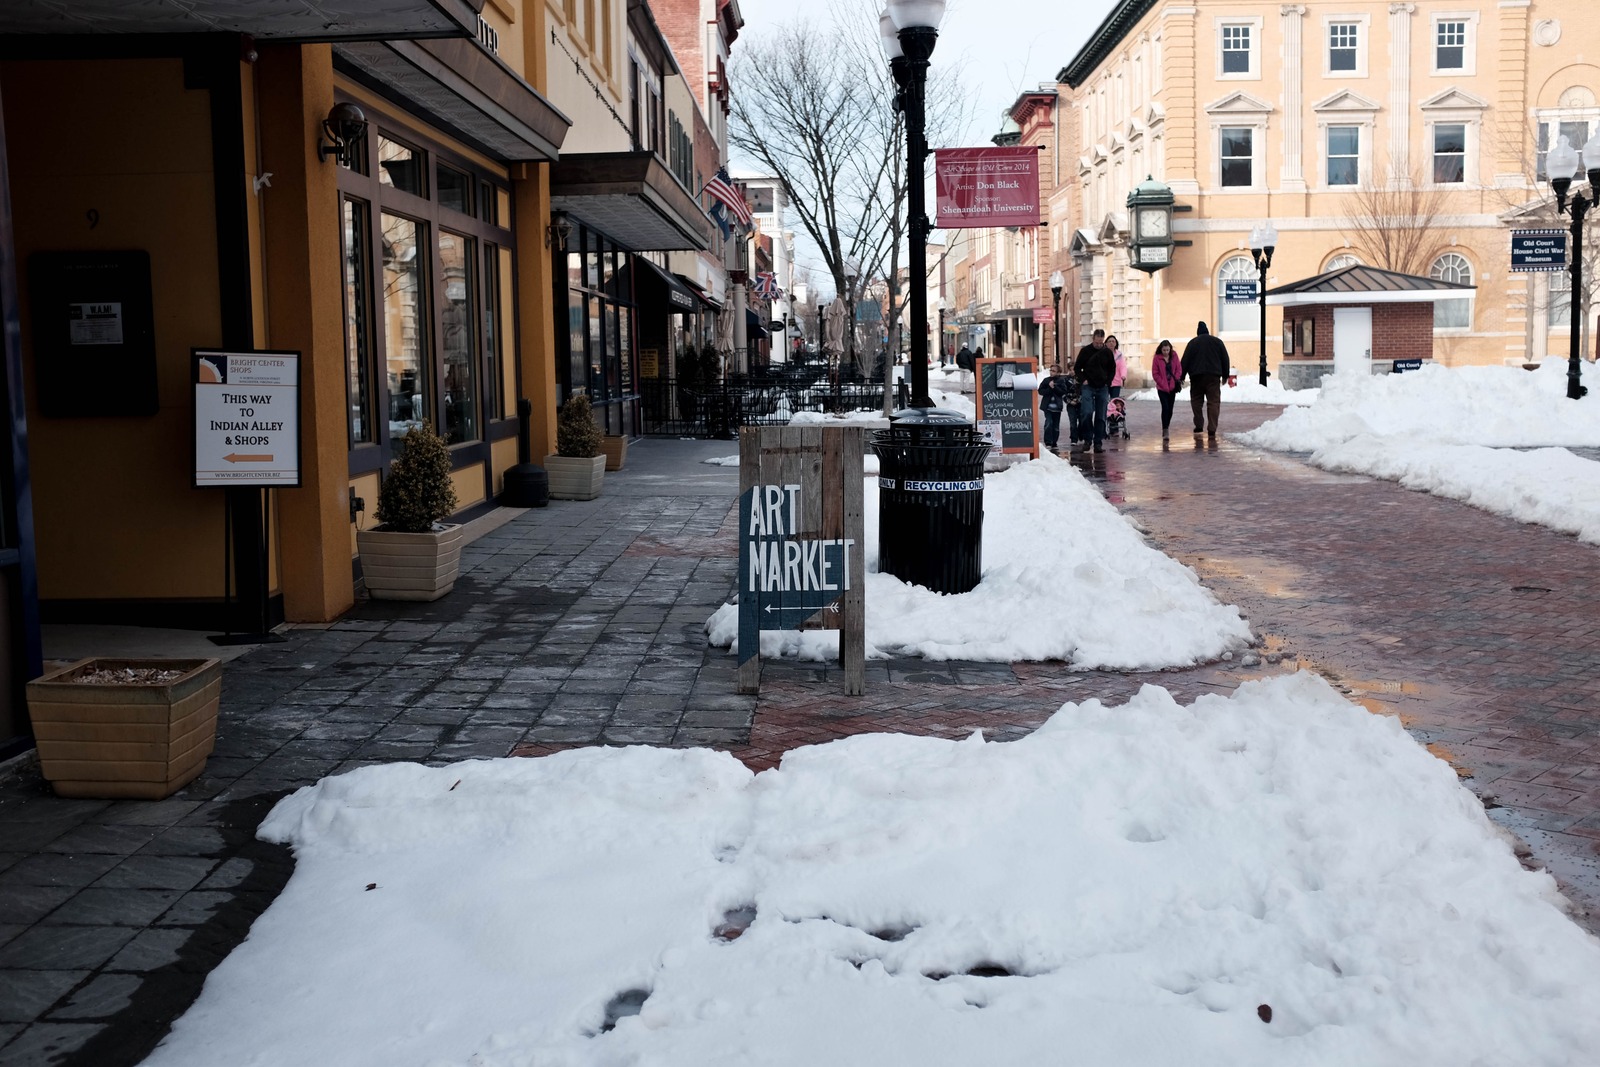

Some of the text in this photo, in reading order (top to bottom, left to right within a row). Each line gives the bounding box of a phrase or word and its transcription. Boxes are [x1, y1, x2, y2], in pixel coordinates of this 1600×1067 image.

[1014, 163, 1030, 171] 2014
[977, 182, 995, 190] Don
[997, 180, 1019, 189] Black
[942, 203, 1034, 214] Shenandoah University
[985, 408, 1032, 418] SOLD OUT!
[225, 436, 233, 445] &
[905, 481, 967, 491] RECYCLING
[749, 484, 801, 536] ART
[749, 538, 855, 592] MARKET
